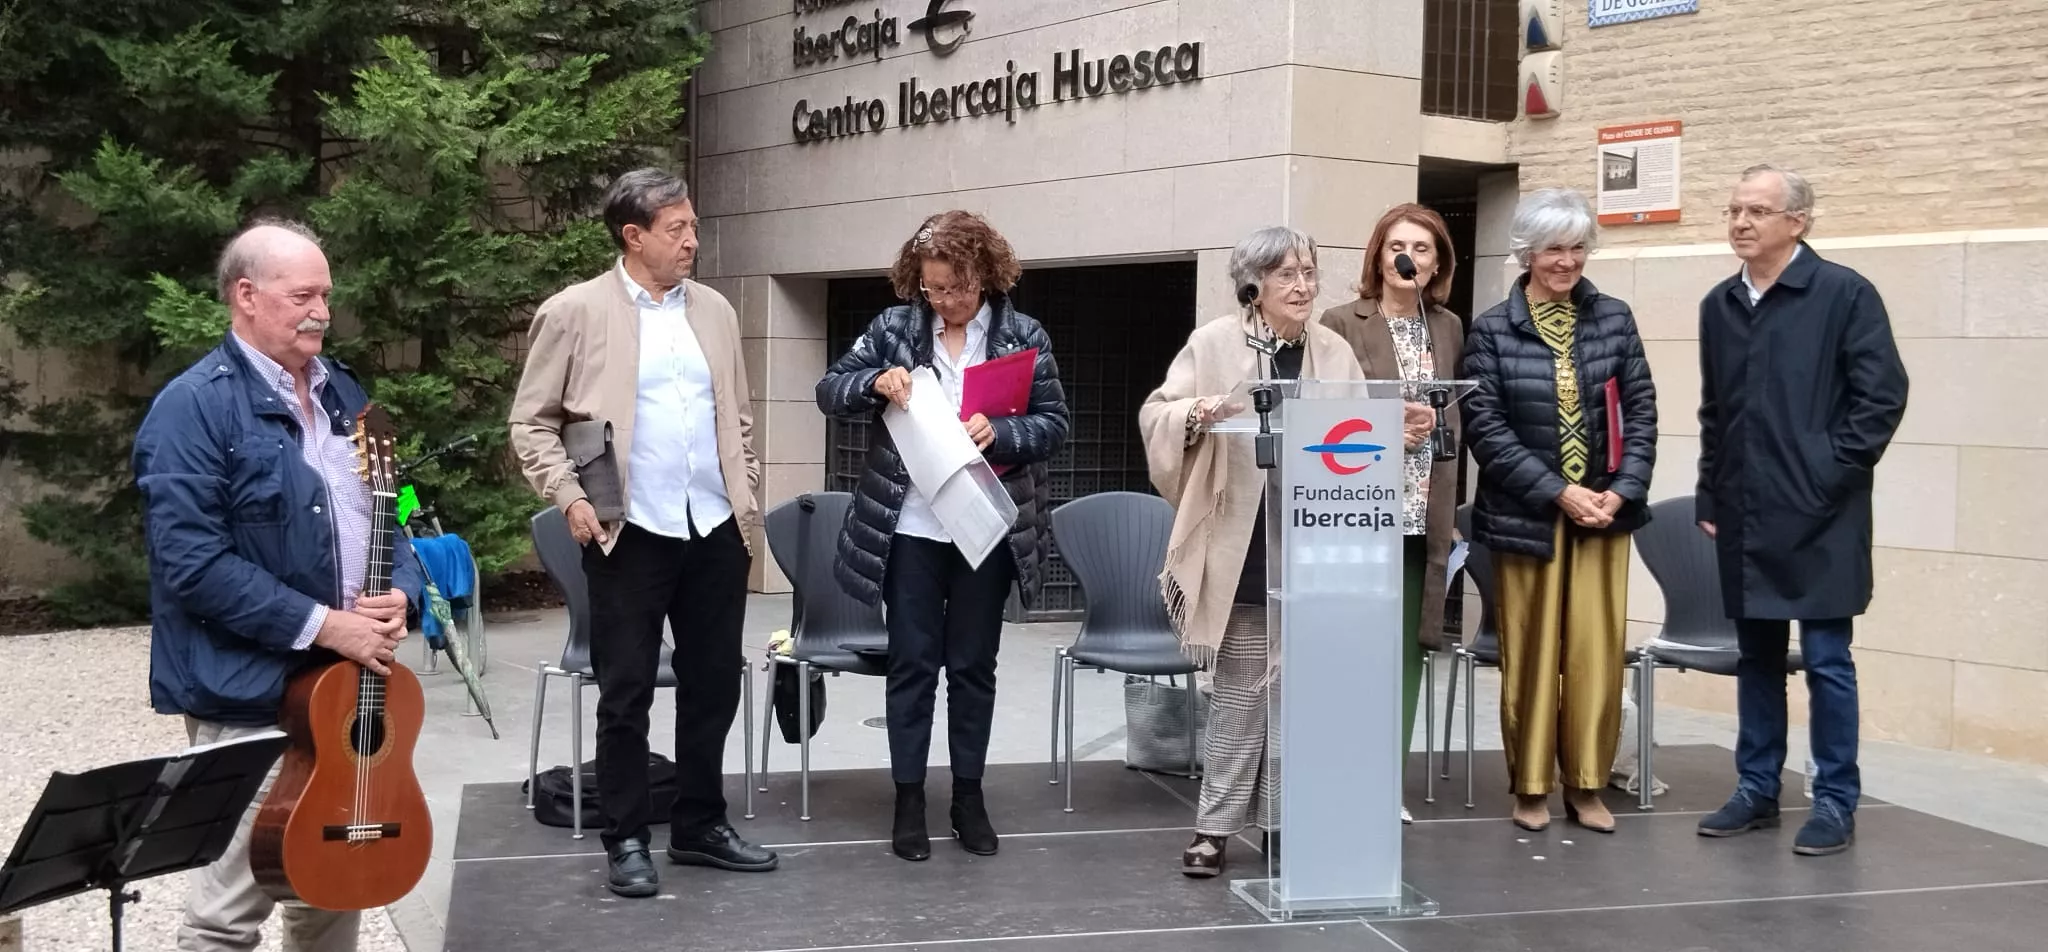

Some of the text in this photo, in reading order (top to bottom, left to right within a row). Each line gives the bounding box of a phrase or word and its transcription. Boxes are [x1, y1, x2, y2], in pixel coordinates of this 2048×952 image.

[793, 42, 1203, 141] Centro Ibercaja Huesca
[1645, 127, 1653, 136] DE
[1293, 485, 1396, 501] Fundación
[1293, 506, 1396, 532] Ibercaja
